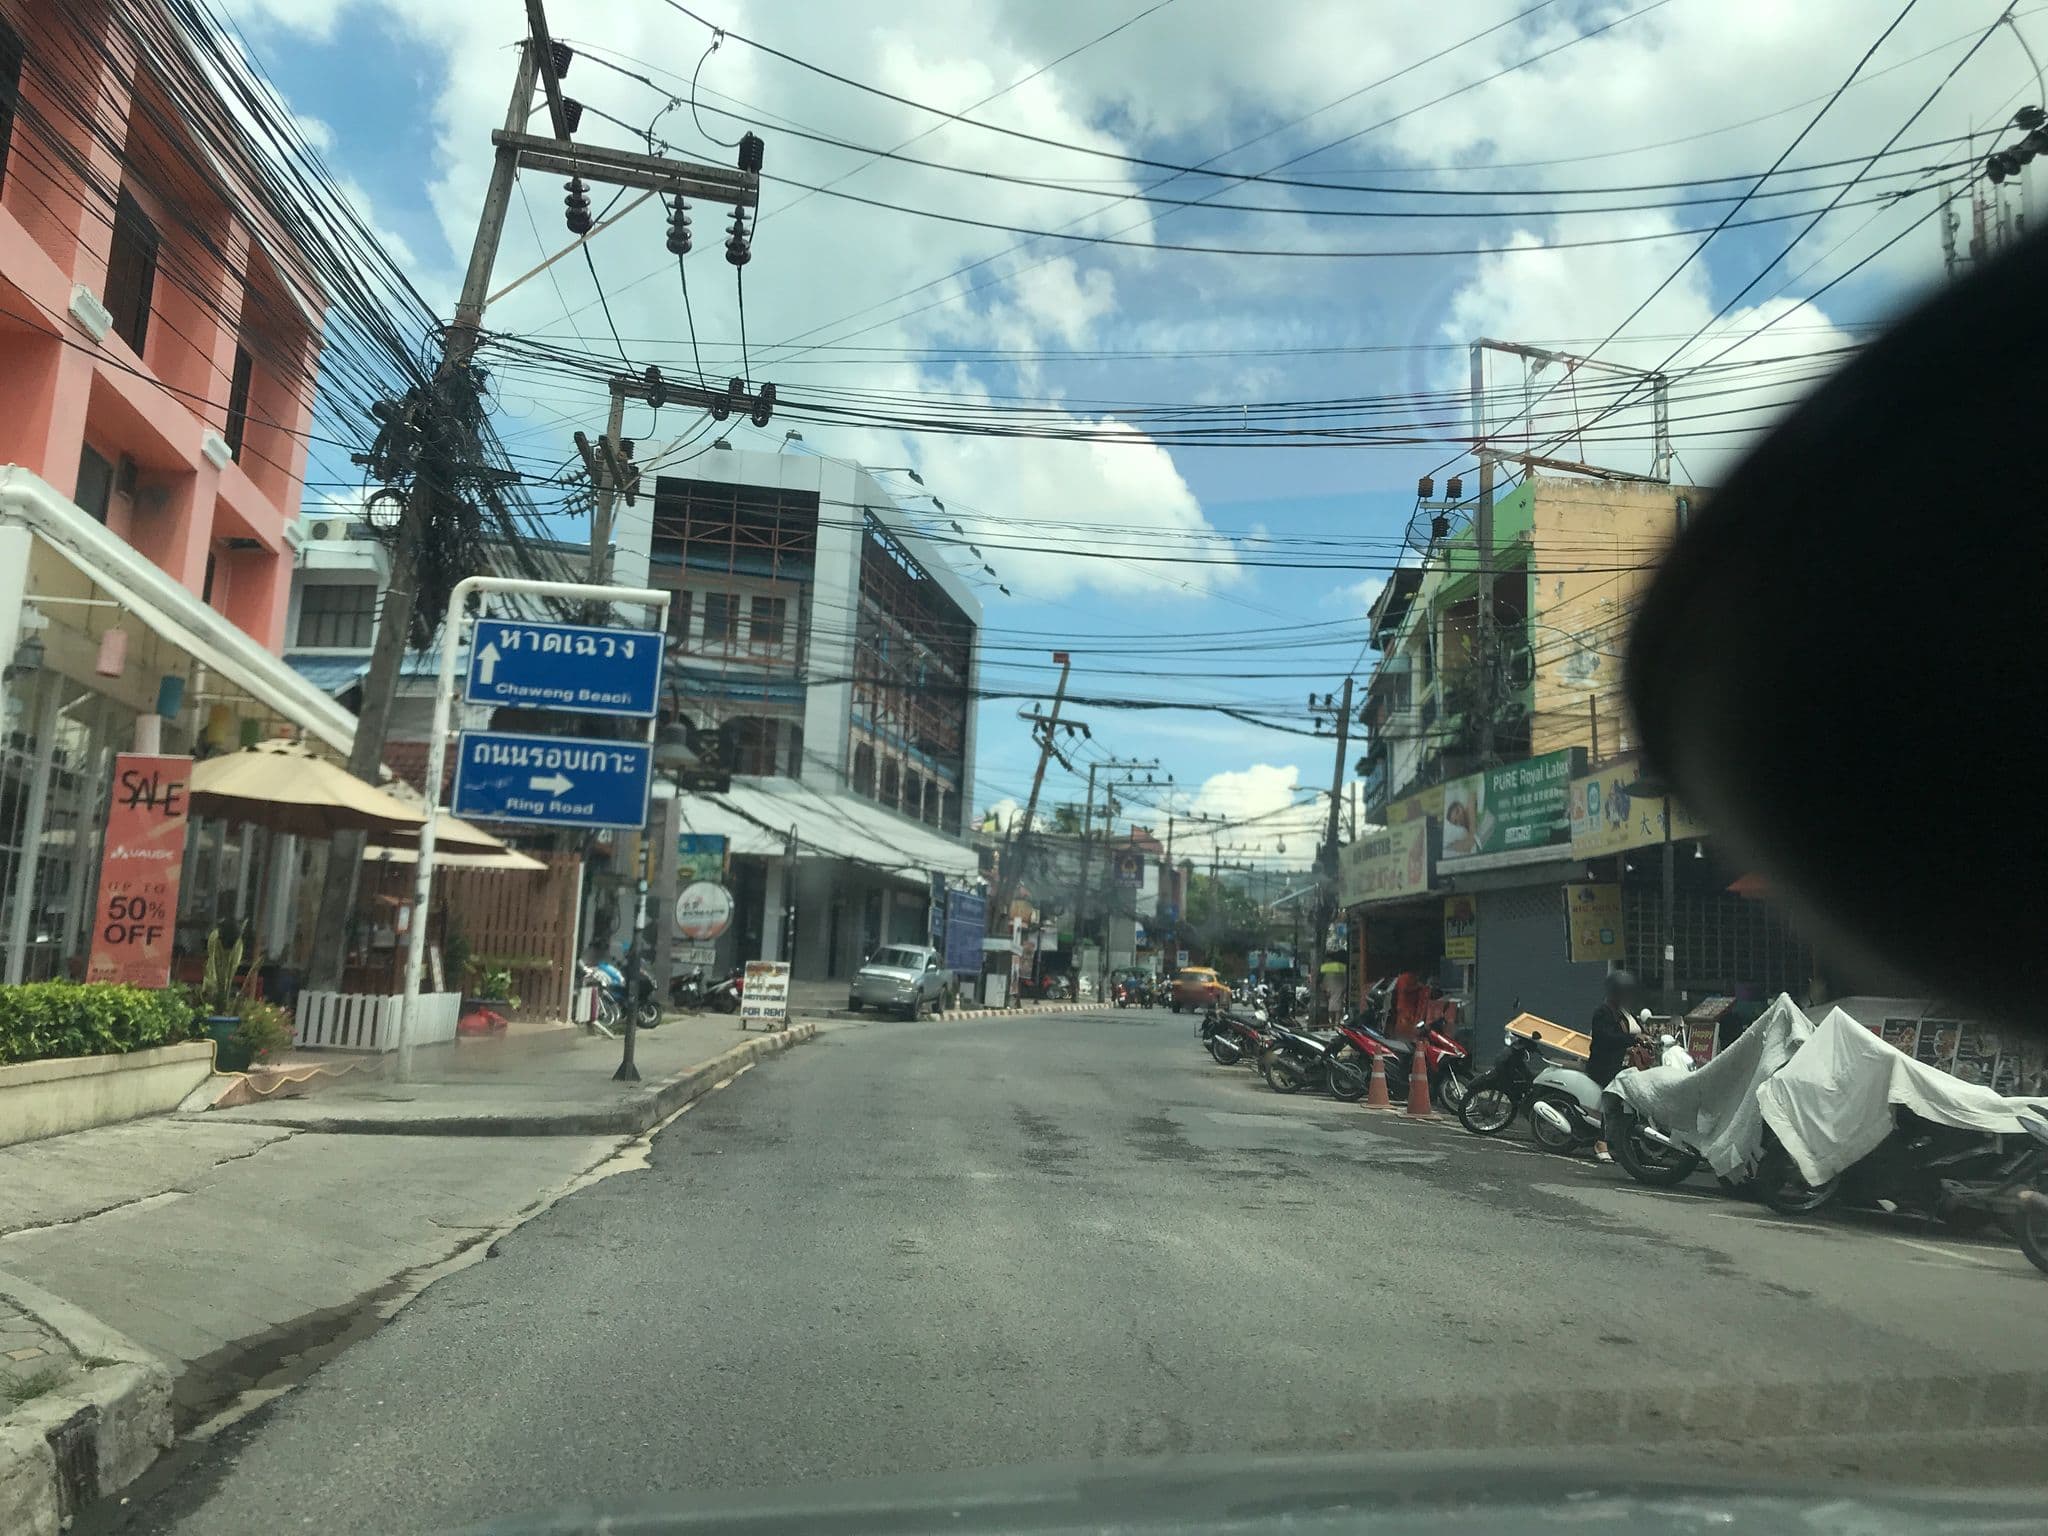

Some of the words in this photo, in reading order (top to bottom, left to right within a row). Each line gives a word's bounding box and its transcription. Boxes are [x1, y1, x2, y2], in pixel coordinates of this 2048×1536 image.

[499, 628, 635, 660] หาดเฉวง
[495, 682, 575, 702] Chaweng
[578, 689, 633, 705] Beach
[473, 742, 636, 774] ถนนรอบเกาะ
[1493, 770, 1518, 792] PURE
[1520, 763, 1544, 786] Royal
[118, 770, 184, 817] SALE
[506, 797, 544, 815] Ring
[549, 801, 594, 816] Road
[108, 896, 166, 921] 50%
[104, 923, 163, 946] OFF
[742, 1007, 760, 1016] FOR
[763, 1007, 786, 1017] RENT
